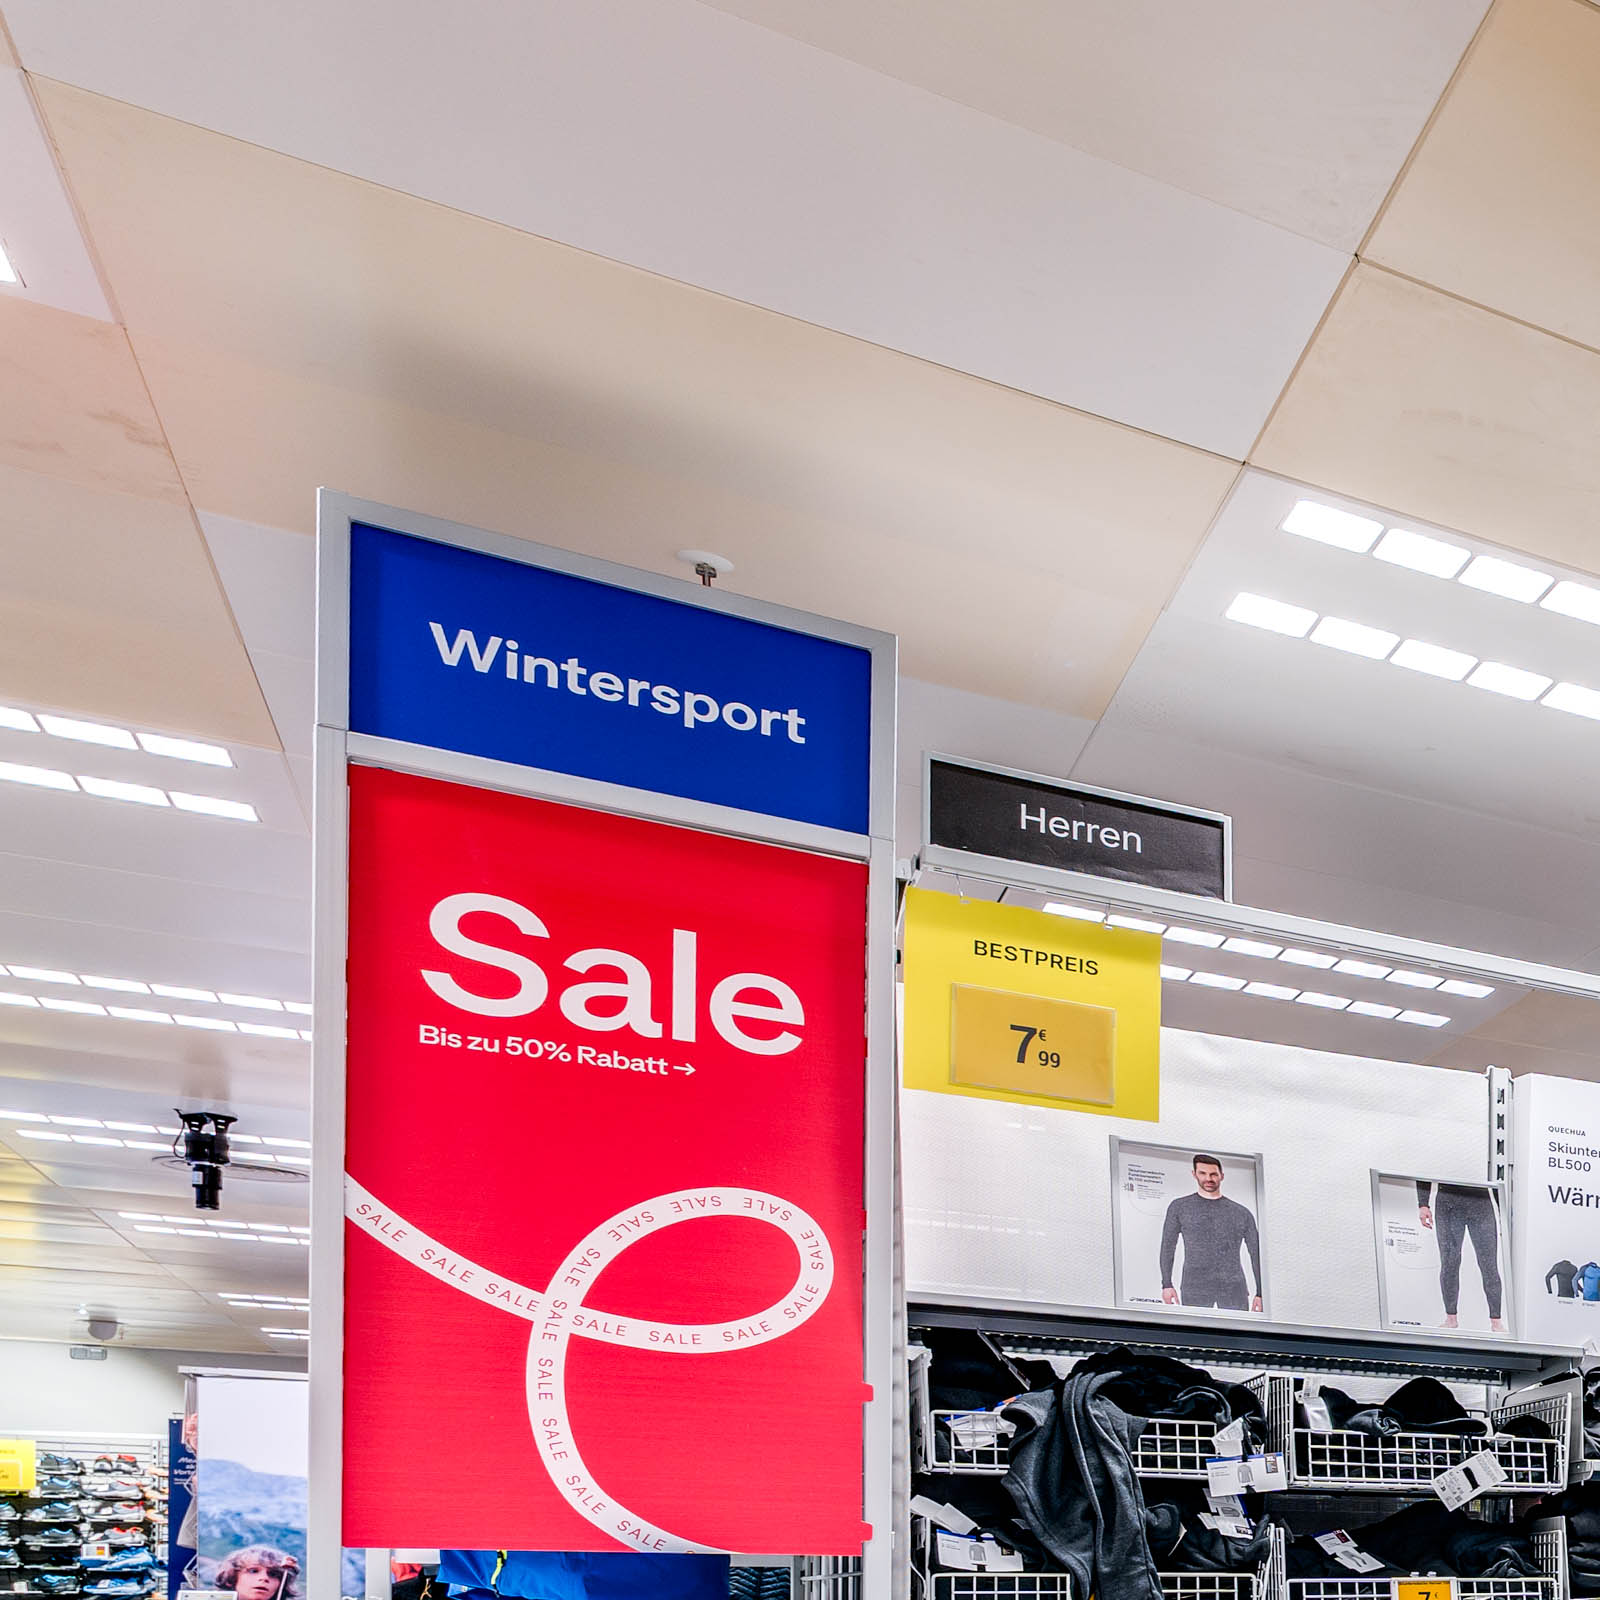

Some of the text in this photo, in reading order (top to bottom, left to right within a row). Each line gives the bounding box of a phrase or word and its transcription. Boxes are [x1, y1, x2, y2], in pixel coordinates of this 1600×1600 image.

[428, 621, 806, 745] Wintersport
[1020, 803, 1142, 853] Herren
[420, 892, 806, 1056] Sale
[973, 940, 1099, 976] BESTPREIS
[418, 1025, 669, 1078] Bis zu 50% Rabatt
[1009, 1024, 1037, 1064] 7
[1038, 1051, 1061, 1068] 99
[1548, 1126, 1586, 1137] QUECHUA
[1548, 1157, 1591, 1172] BL500
[355, 1195, 825, 1552] SALE SALE SALE SALE SALE SALE SALE SALE SALE SALE SALE SALE SALE SALE SALE SALE SALE
